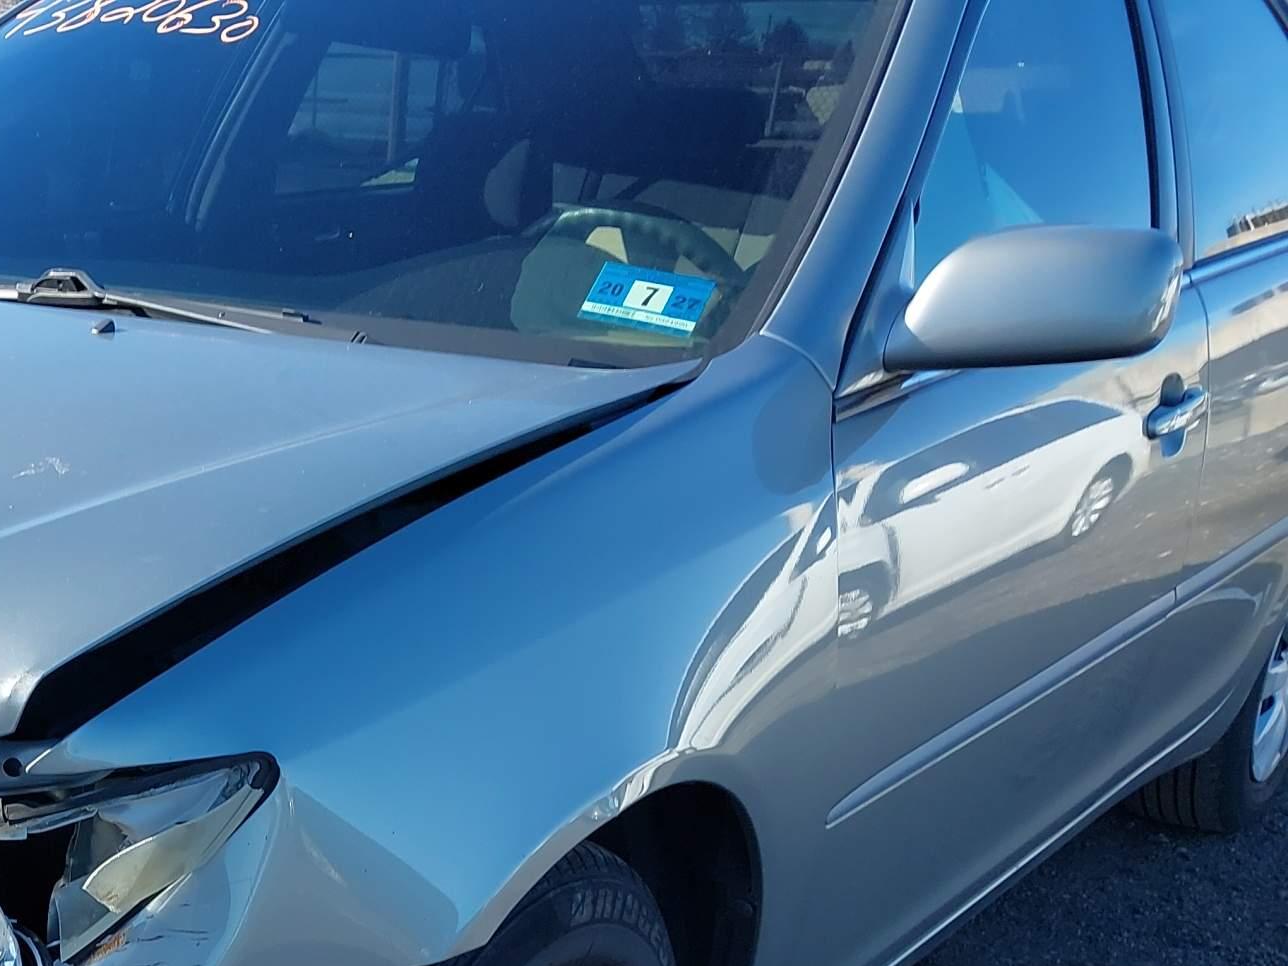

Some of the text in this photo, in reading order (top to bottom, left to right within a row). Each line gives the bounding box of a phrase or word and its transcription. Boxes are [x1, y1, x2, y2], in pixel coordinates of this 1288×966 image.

[599, 280, 701, 311] 20 7 27
